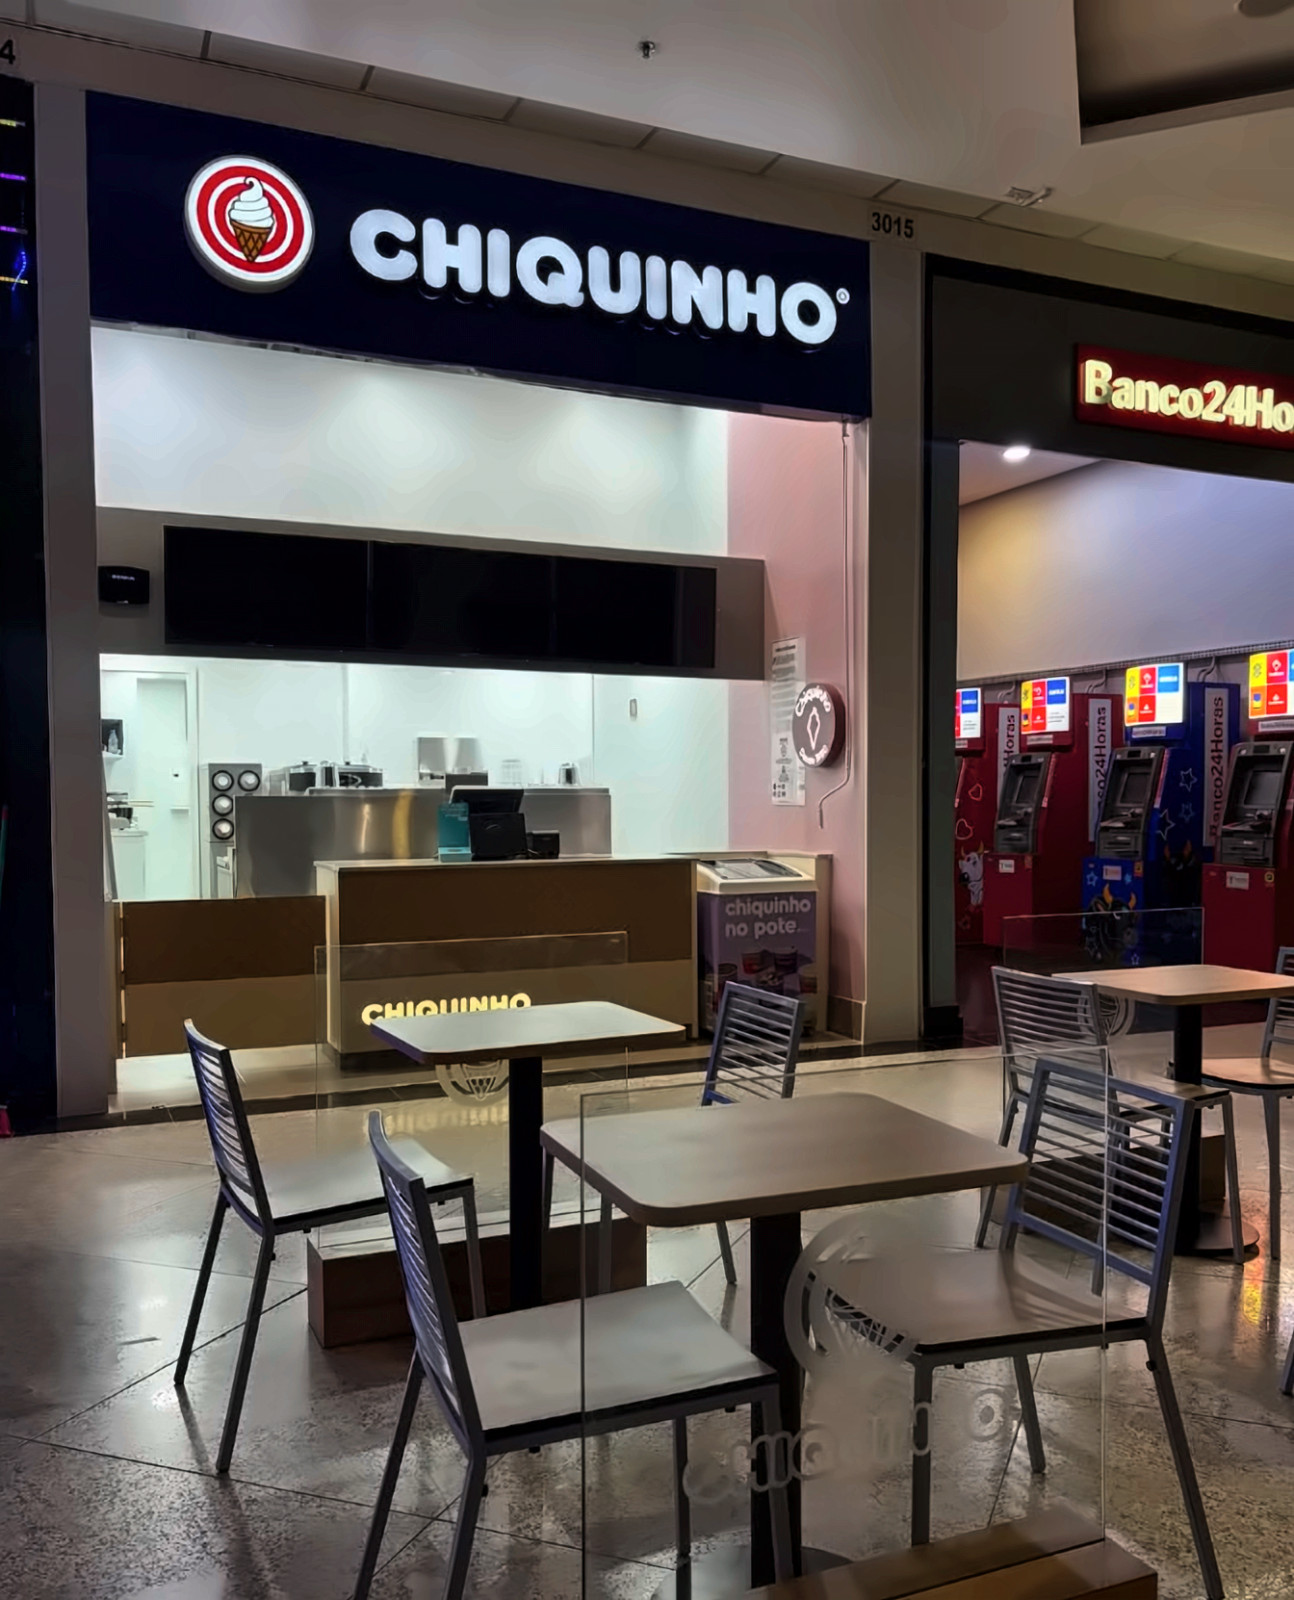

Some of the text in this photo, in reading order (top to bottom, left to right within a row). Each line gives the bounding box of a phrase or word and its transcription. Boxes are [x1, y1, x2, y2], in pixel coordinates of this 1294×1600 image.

[0, 38, 16, 65] 4
[871, 211, 914, 239] 3015
[725, 896, 811, 918] chiquinho
[725, 922, 748, 937] no
